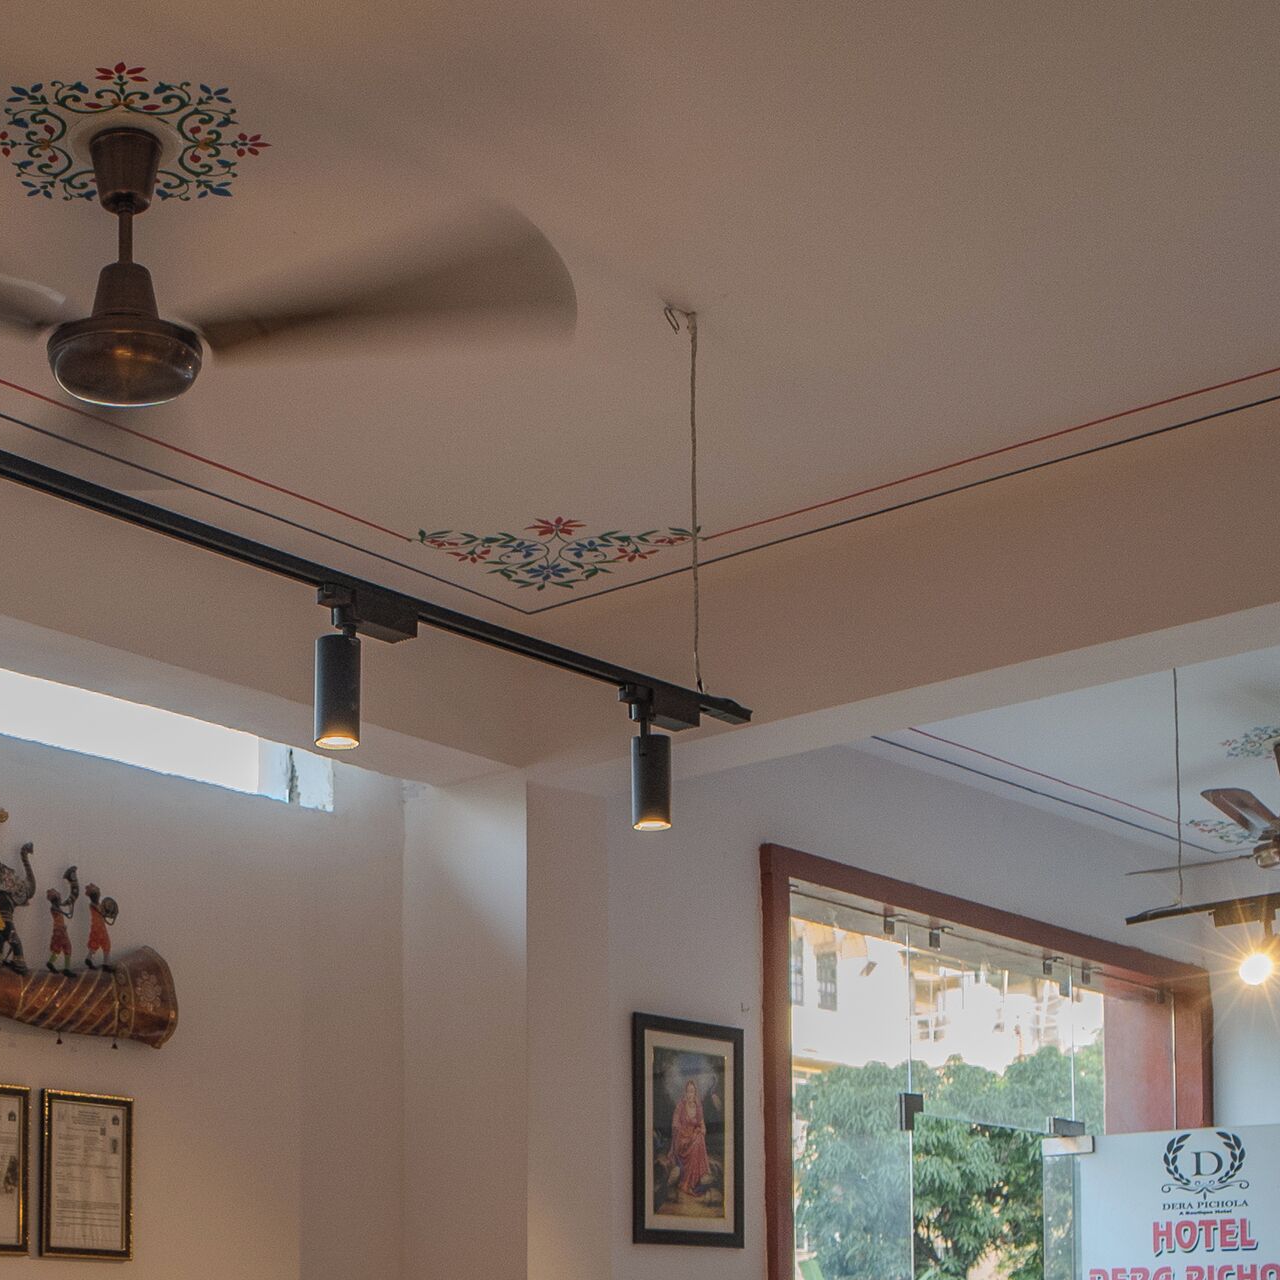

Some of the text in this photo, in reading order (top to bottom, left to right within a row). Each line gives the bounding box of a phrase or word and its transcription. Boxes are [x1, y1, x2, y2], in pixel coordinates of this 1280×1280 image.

[1192, 1151, 1224, 1177] D
[1162, 1199, 1249, 1211] DERA PICHOLA
[1152, 1217, 1258, 1257] HOTEL
